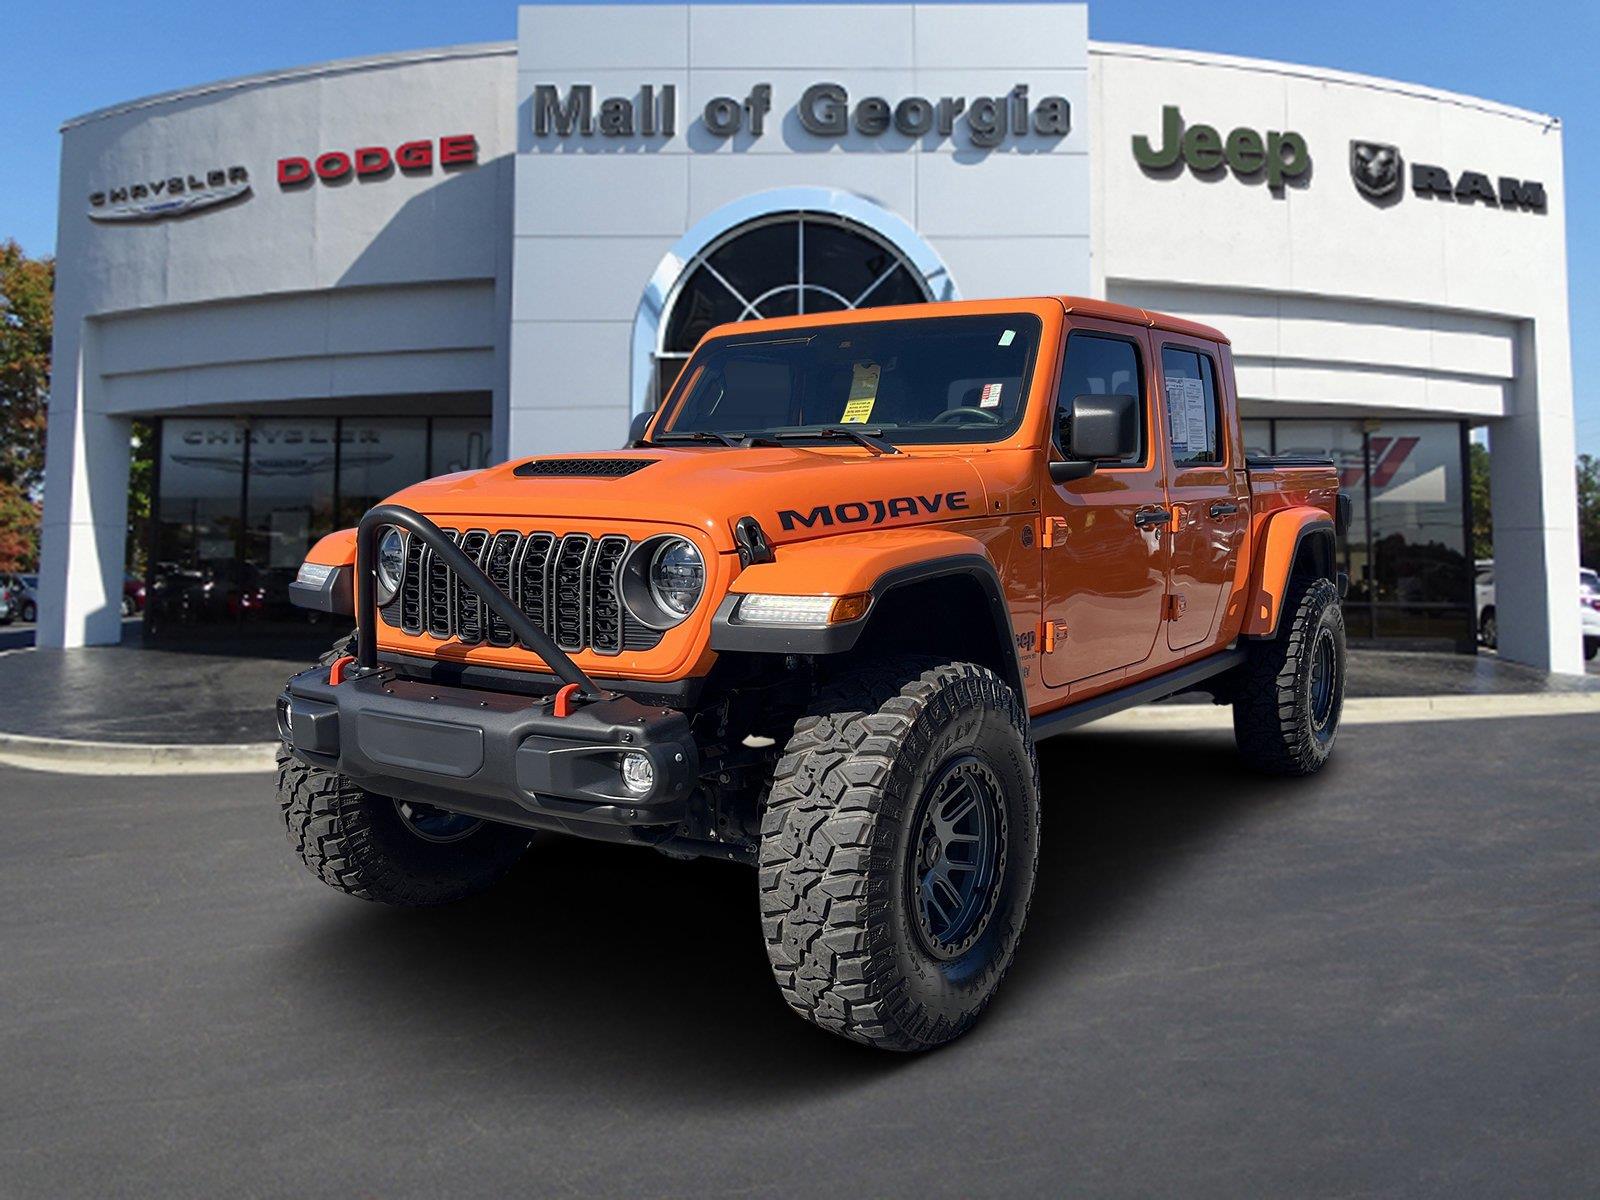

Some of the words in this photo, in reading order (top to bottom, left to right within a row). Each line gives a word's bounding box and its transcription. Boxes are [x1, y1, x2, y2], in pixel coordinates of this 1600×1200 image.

[533, 84, 677, 137] Mall
[704, 83, 771, 137] of
[800, 82, 1071, 148] Georgia
[277, 134, 476, 184] DODGE
[1131, 105, 1309, 191] Jeep
[89, 166, 249, 206] CHRYSLER
[1410, 162, 1547, 210] RAM
[777, 491, 969, 531] MOJAVE
